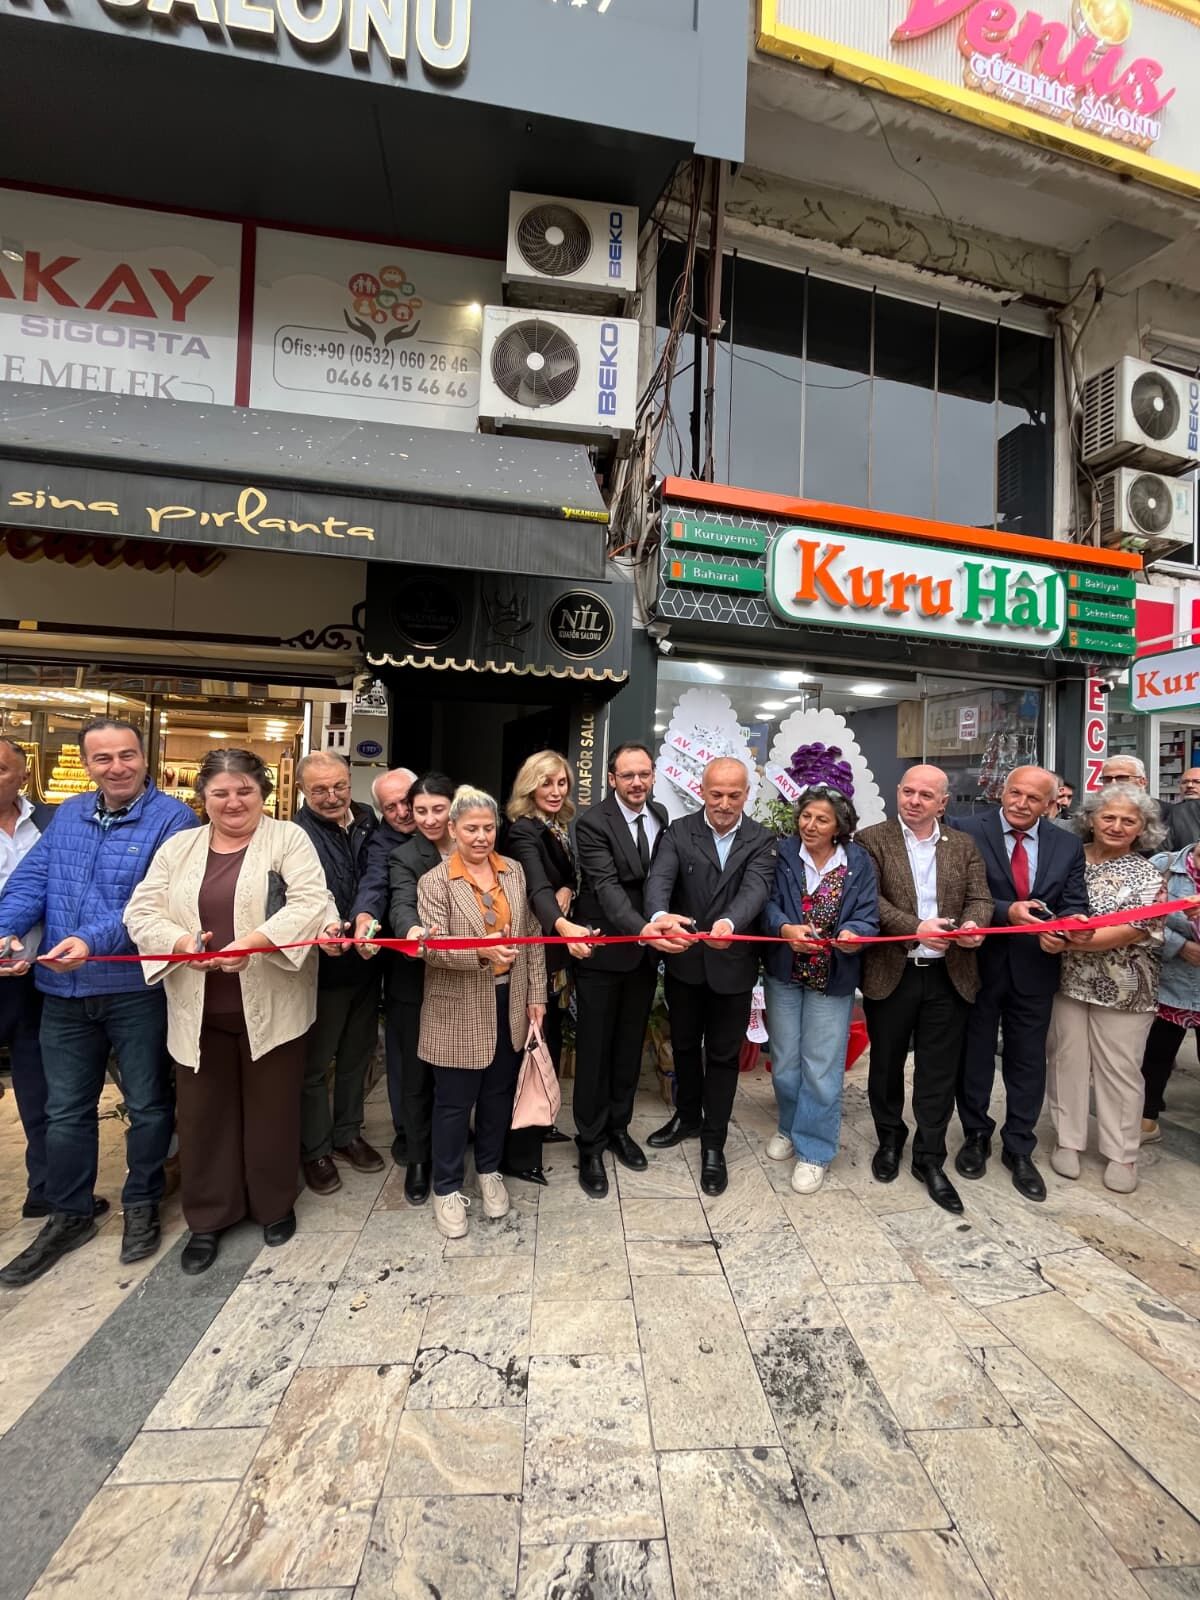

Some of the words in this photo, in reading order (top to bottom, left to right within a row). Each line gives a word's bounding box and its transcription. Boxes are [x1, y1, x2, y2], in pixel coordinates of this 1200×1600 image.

[98, 0, 470, 68] ONU
[609, 211, 622, 278] BEKO
[0, 251, 215, 322] KAY
[38, 358, 180, 400] MELEK
[326, 367, 373, 388] 0466
[379, 373, 412, 392] 415
[418, 378, 440, 395] 46
[446, 382, 468, 398] 46
[350, 342, 394, 370] (0532)
[399, 350, 424, 370] 060
[430, 354, 446, 371] 26
[451, 357, 468, 373] 46
[598, 323, 618, 415] BEKO
[1188, 382, 1200, 452] BEKO
[8, 490, 120, 516] sina
[693, 566, 739, 583] Baharat
[795, 538, 954, 616] Kuru
[962, 560, 1060, 631] Hâl
[577, 749, 593, 806] KUAFÖR
